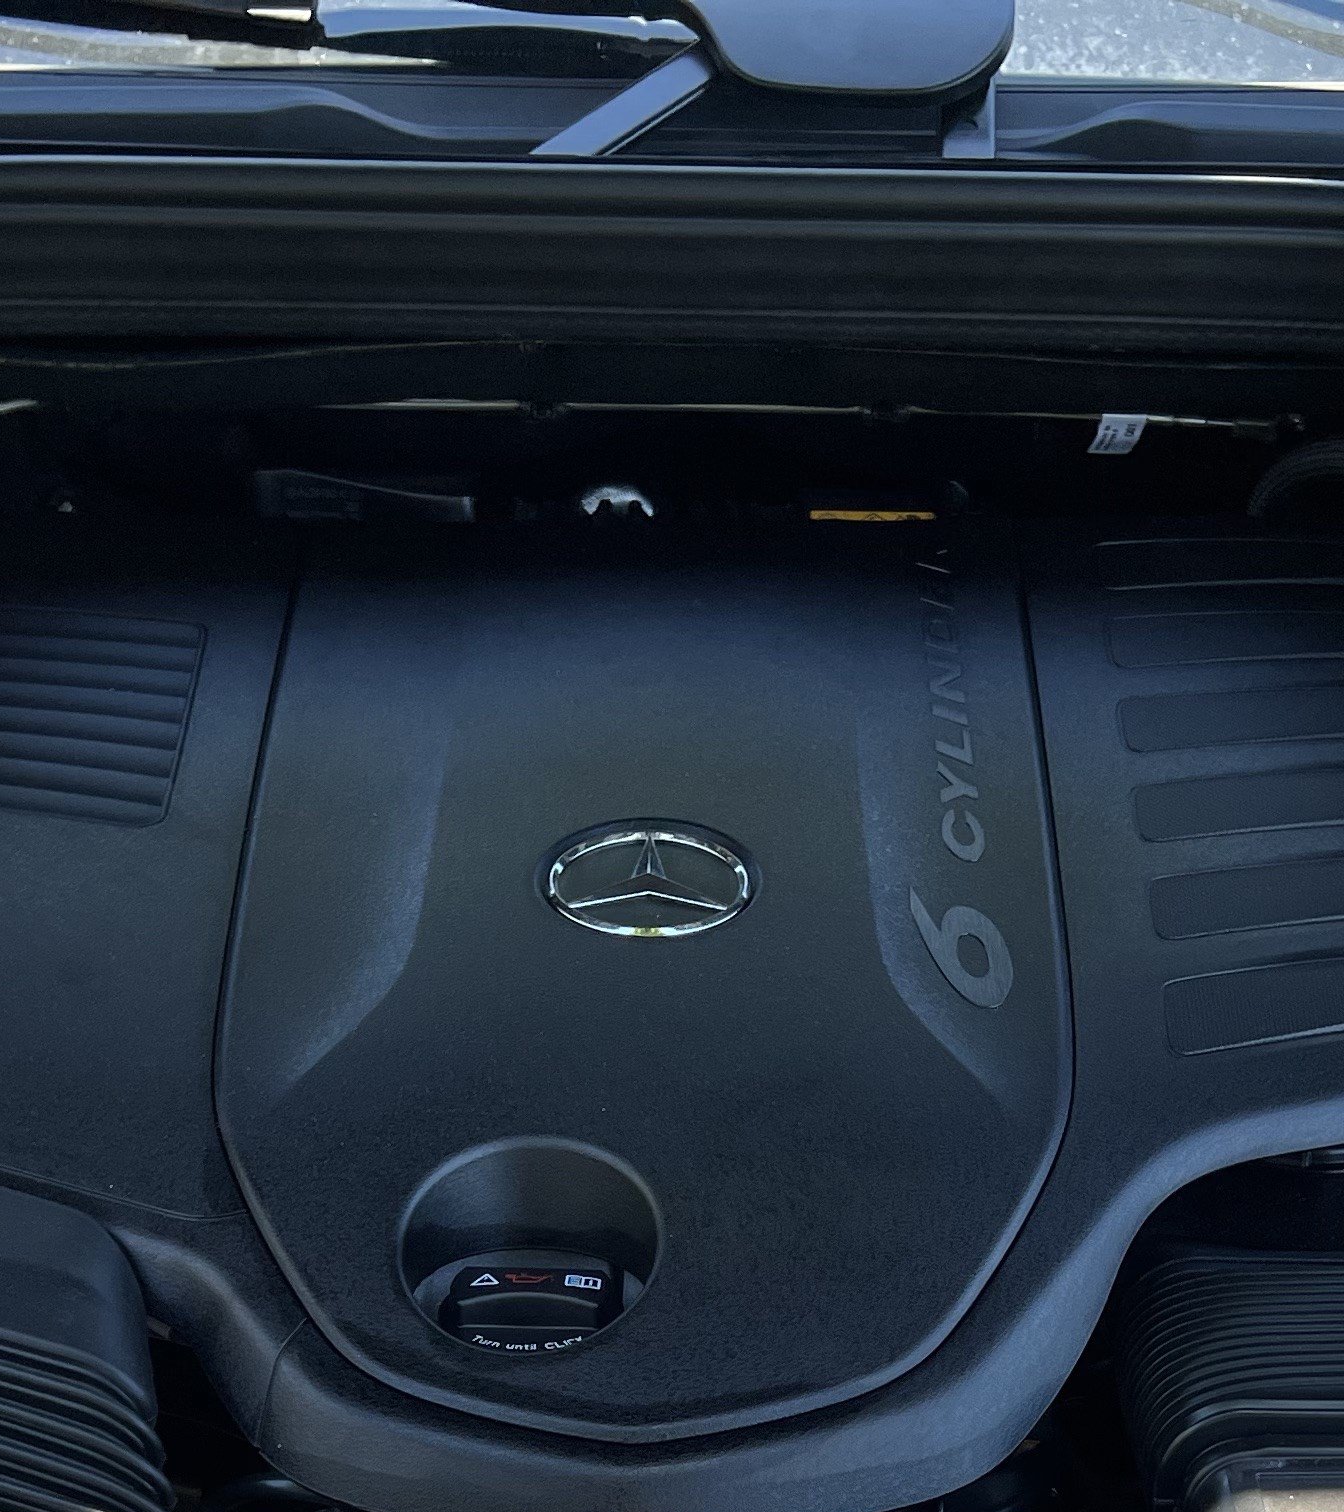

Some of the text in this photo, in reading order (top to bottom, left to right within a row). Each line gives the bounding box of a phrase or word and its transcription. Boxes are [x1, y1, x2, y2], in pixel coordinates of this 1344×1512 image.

[909, 548, 1014, 1010] 6 CYLIND
[471, 1334, 501, 1349] Turn
[505, 1342, 537, 1351] until
